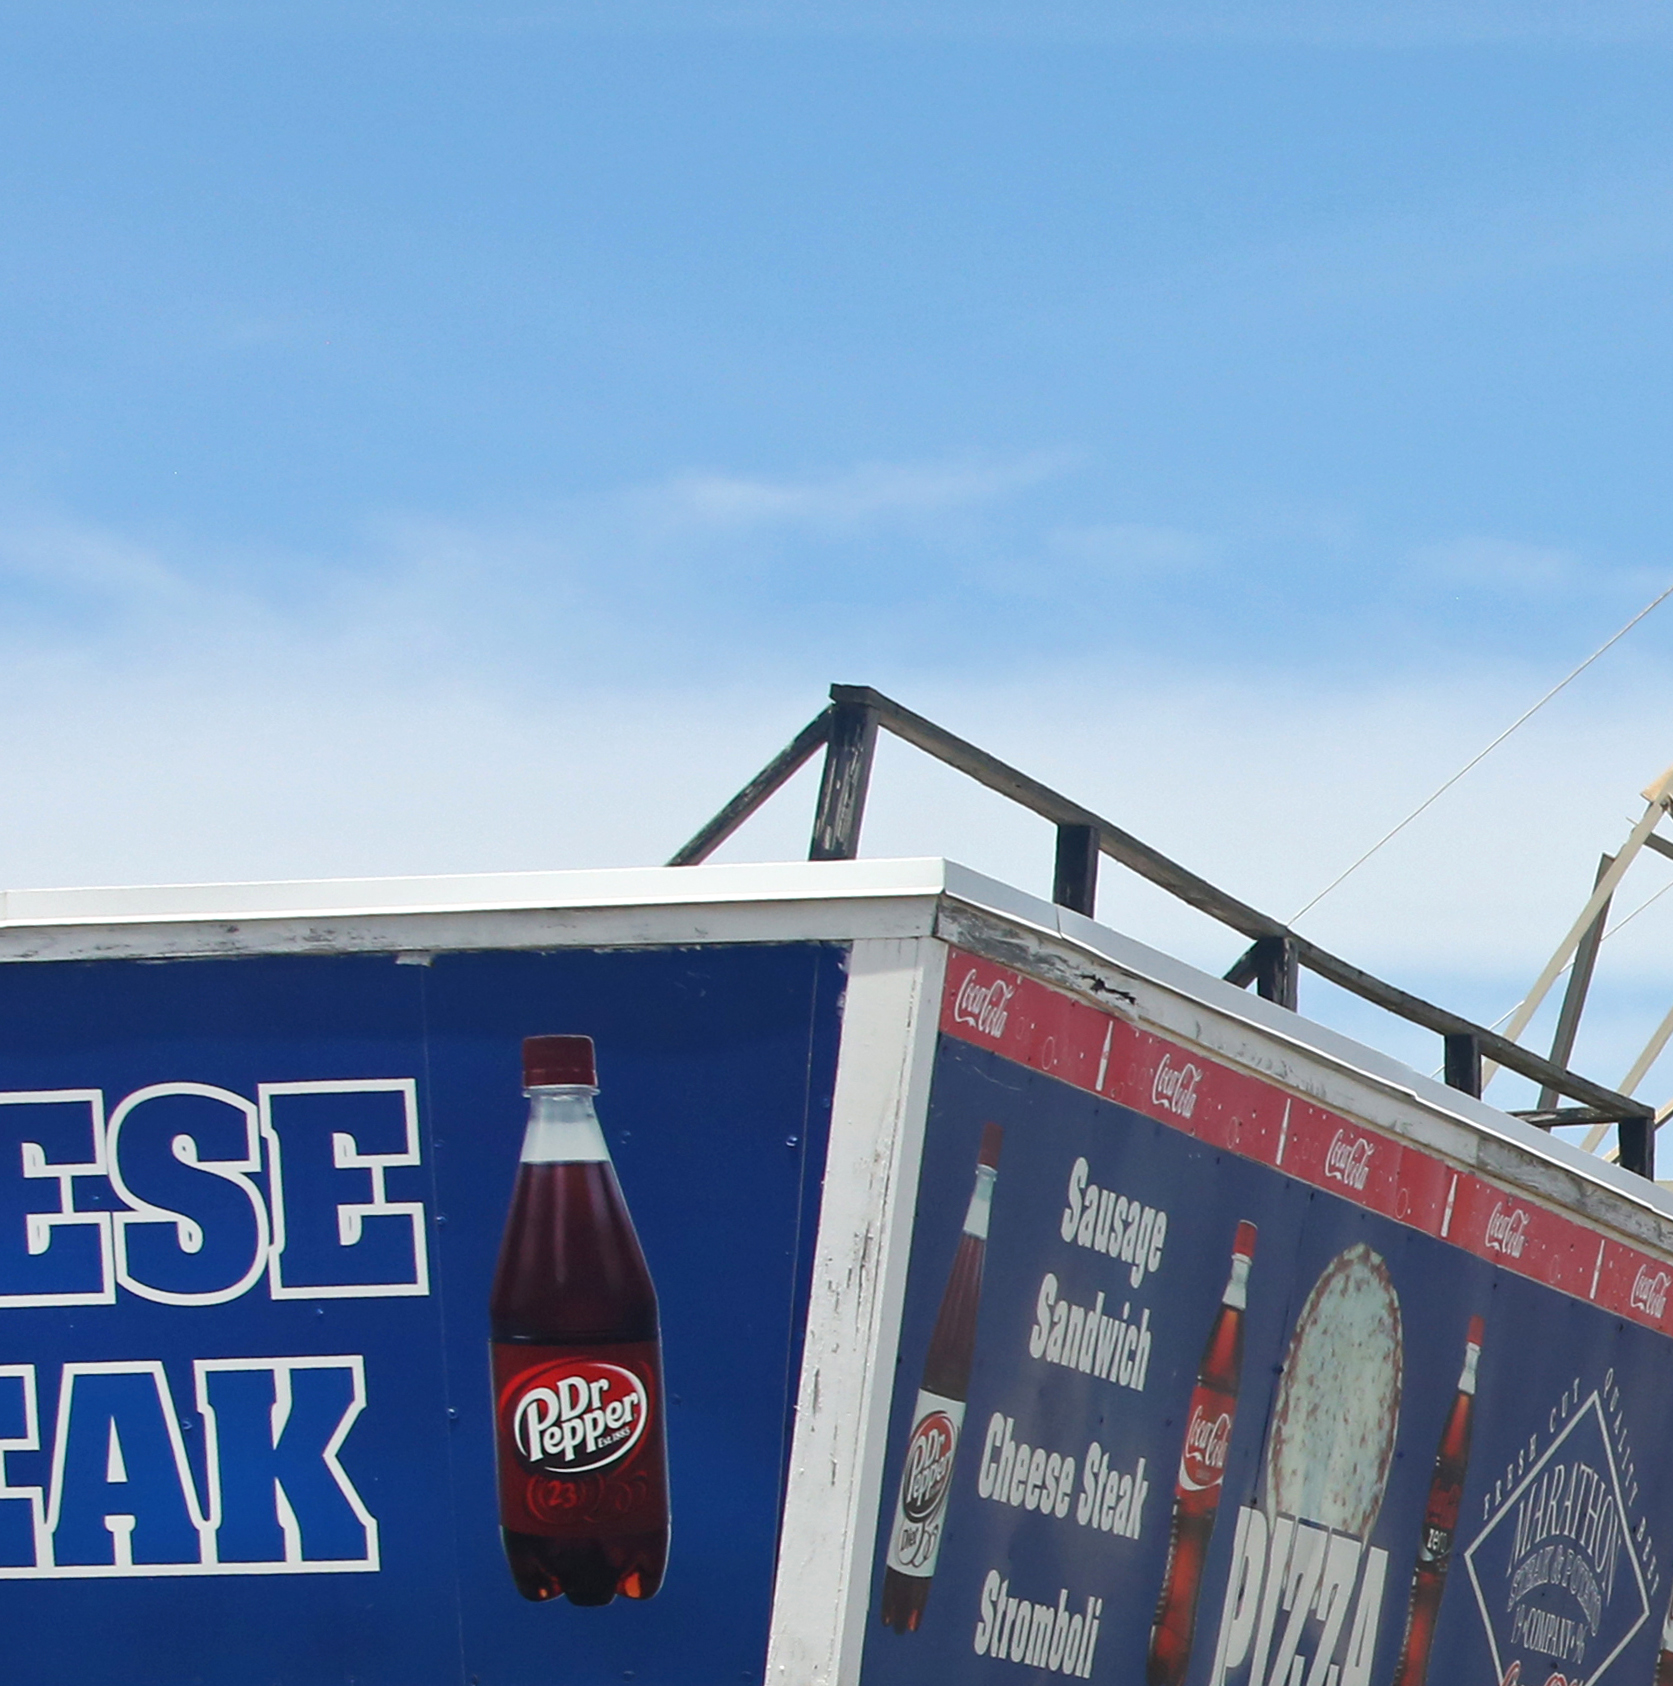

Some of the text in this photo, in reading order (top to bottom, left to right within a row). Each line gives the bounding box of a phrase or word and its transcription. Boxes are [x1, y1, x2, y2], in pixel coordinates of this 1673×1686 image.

[1060, 1156, 1168, 1290] Sausage
[1028, 1272, 1152, 1393] Sandwich
[514, 1387, 638, 1461] Pepper
[557, 1376, 609, 1421] Dr
[923, 1427, 947, 1462] Dr
[904, 1436, 952, 1507] Pepper
[977, 1411, 1150, 1541] Cheese Steak
[1505, 1462, 1622, 1607] MARATHON
[974, 1568, 1103, 1679] Stromboli
